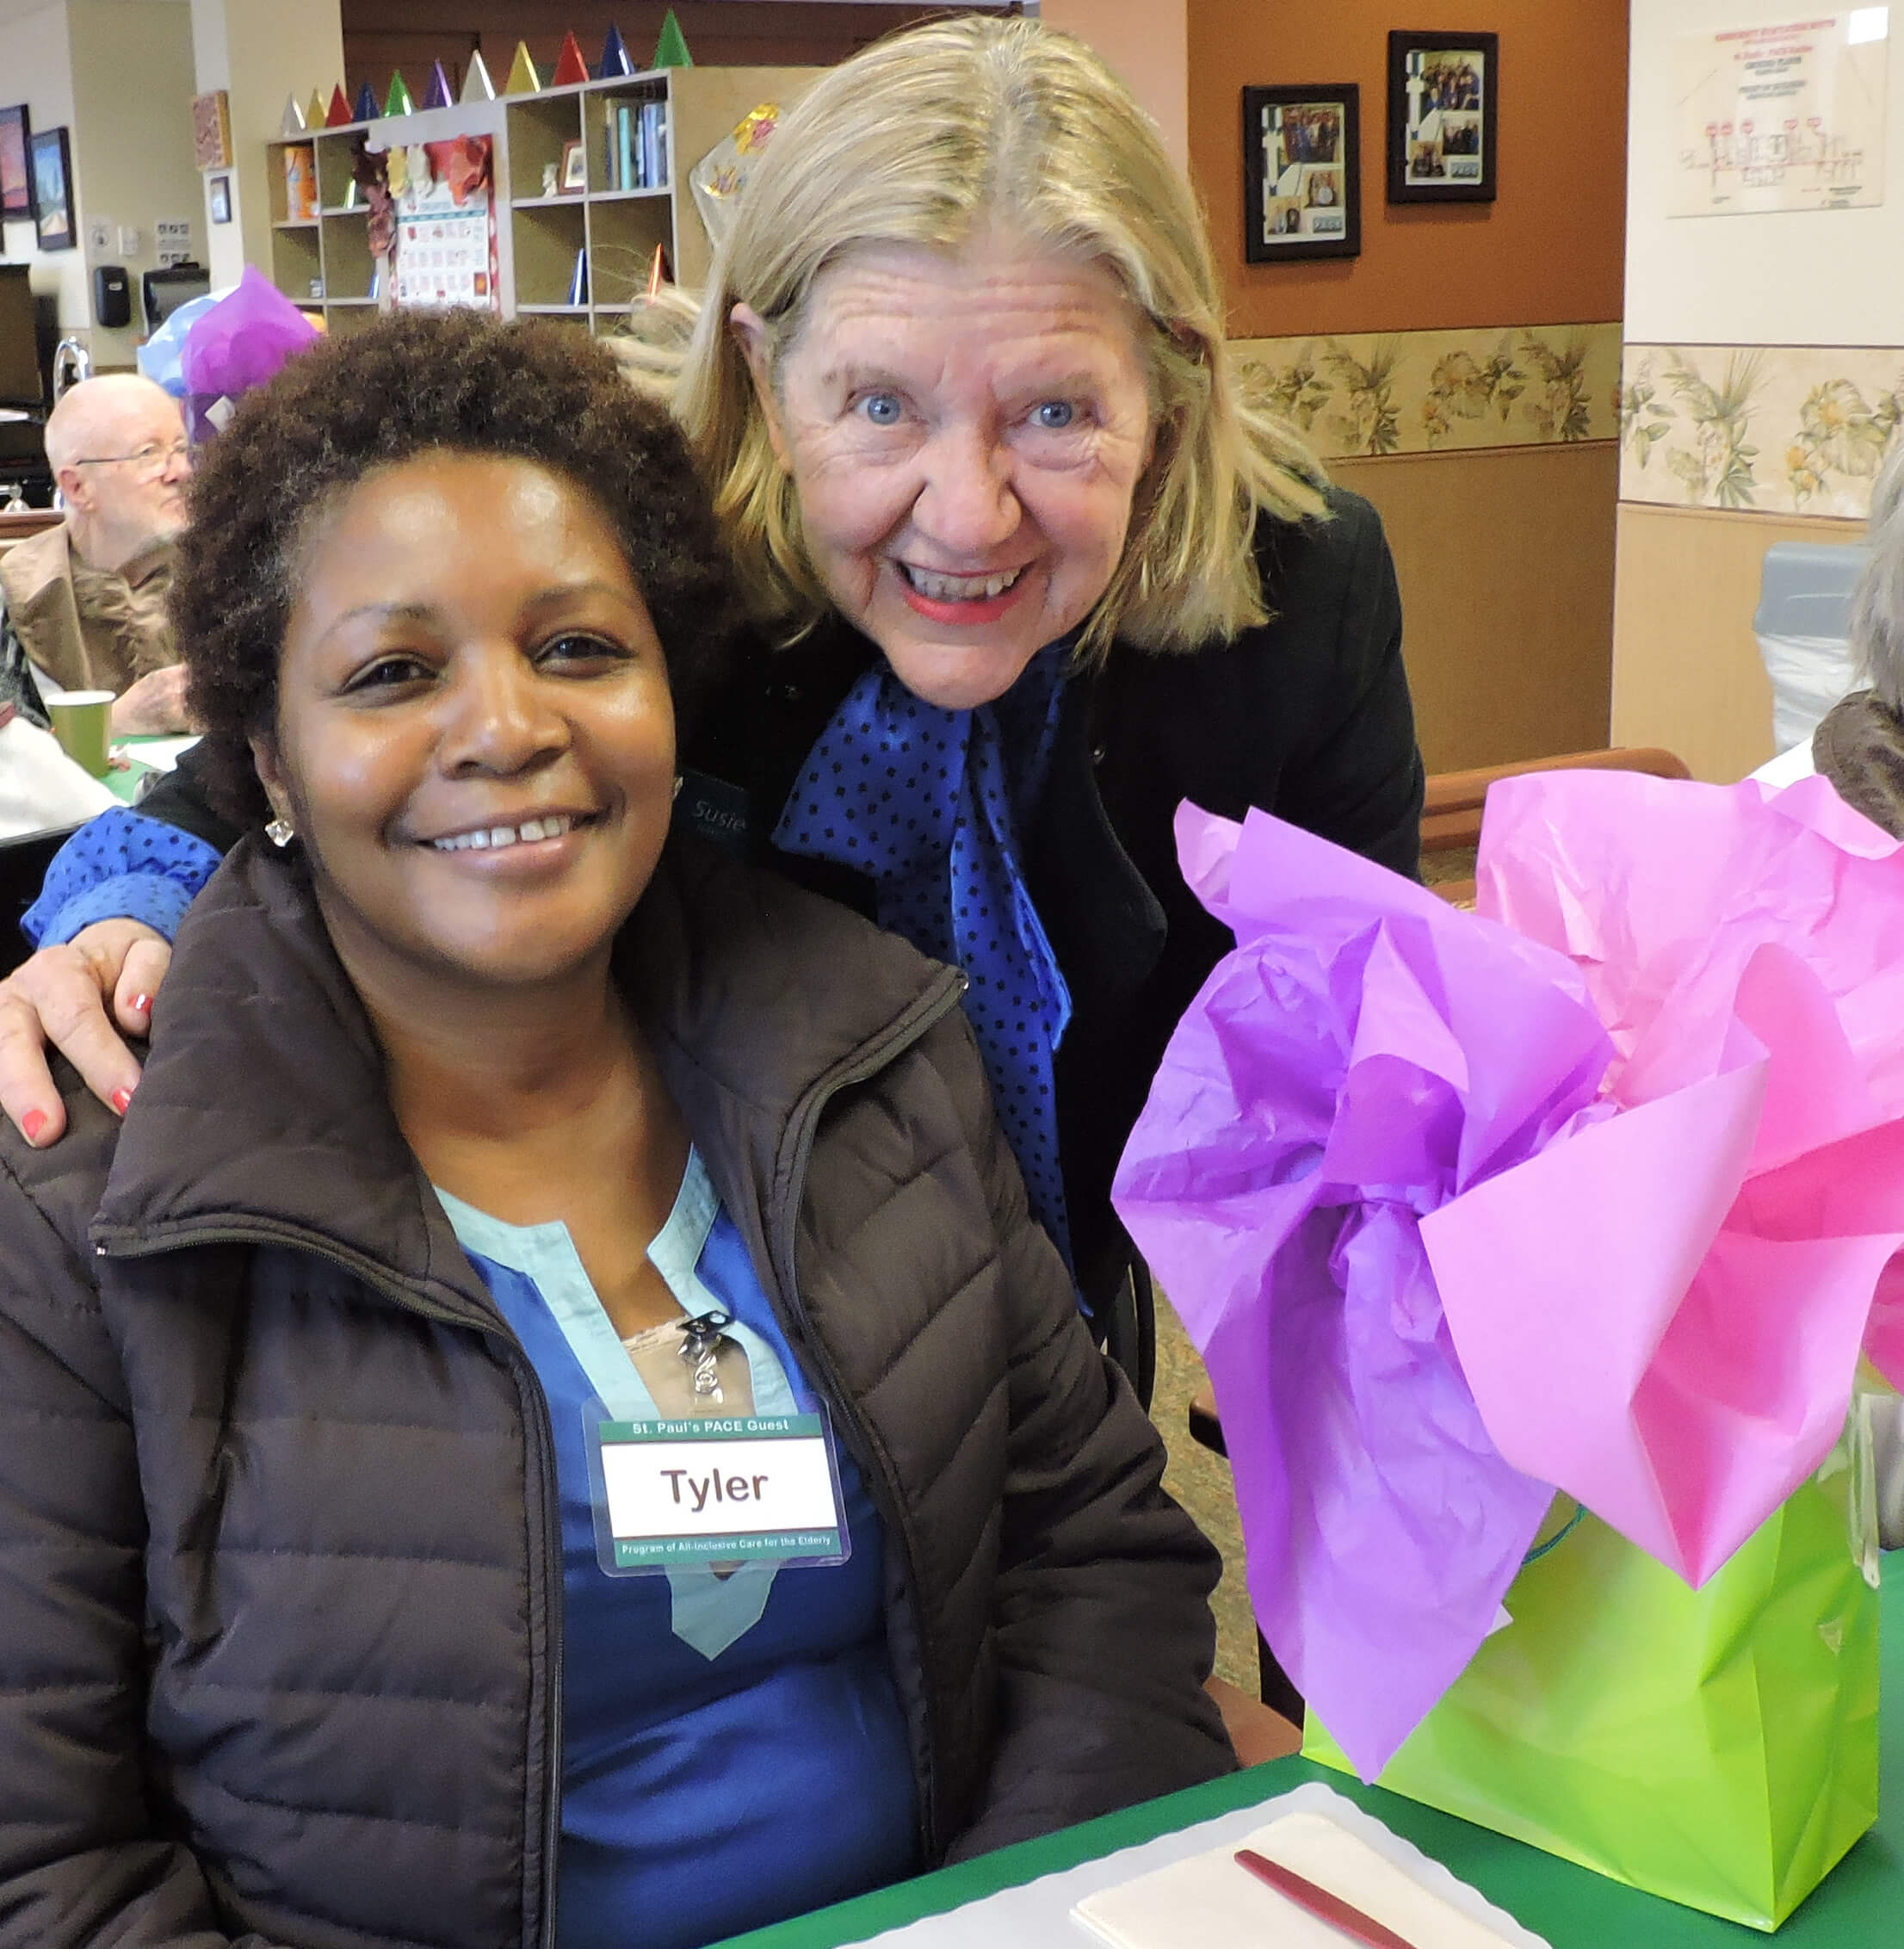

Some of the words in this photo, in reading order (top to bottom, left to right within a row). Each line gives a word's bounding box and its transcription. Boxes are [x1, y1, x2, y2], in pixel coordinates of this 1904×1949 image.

[692, 800, 746, 831] Susie
[633, 1423, 652, 1434] St.
[657, 1420, 700, 1433] Paul's
[704, 1420, 743, 1432] PACE
[747, 1418, 789, 1432] Guest
[659, 1468, 769, 1513] Tyler
[622, 1544, 664, 1556] Program
[666, 1542, 676, 1553] of
[678, 1540, 737, 1551] All-Inclusive
[739, 1538, 763, 1549] Care
[764, 1538, 777, 1547] for
[781, 1537, 796, 1546] the
[798, 1535, 831, 1546] Elderly
